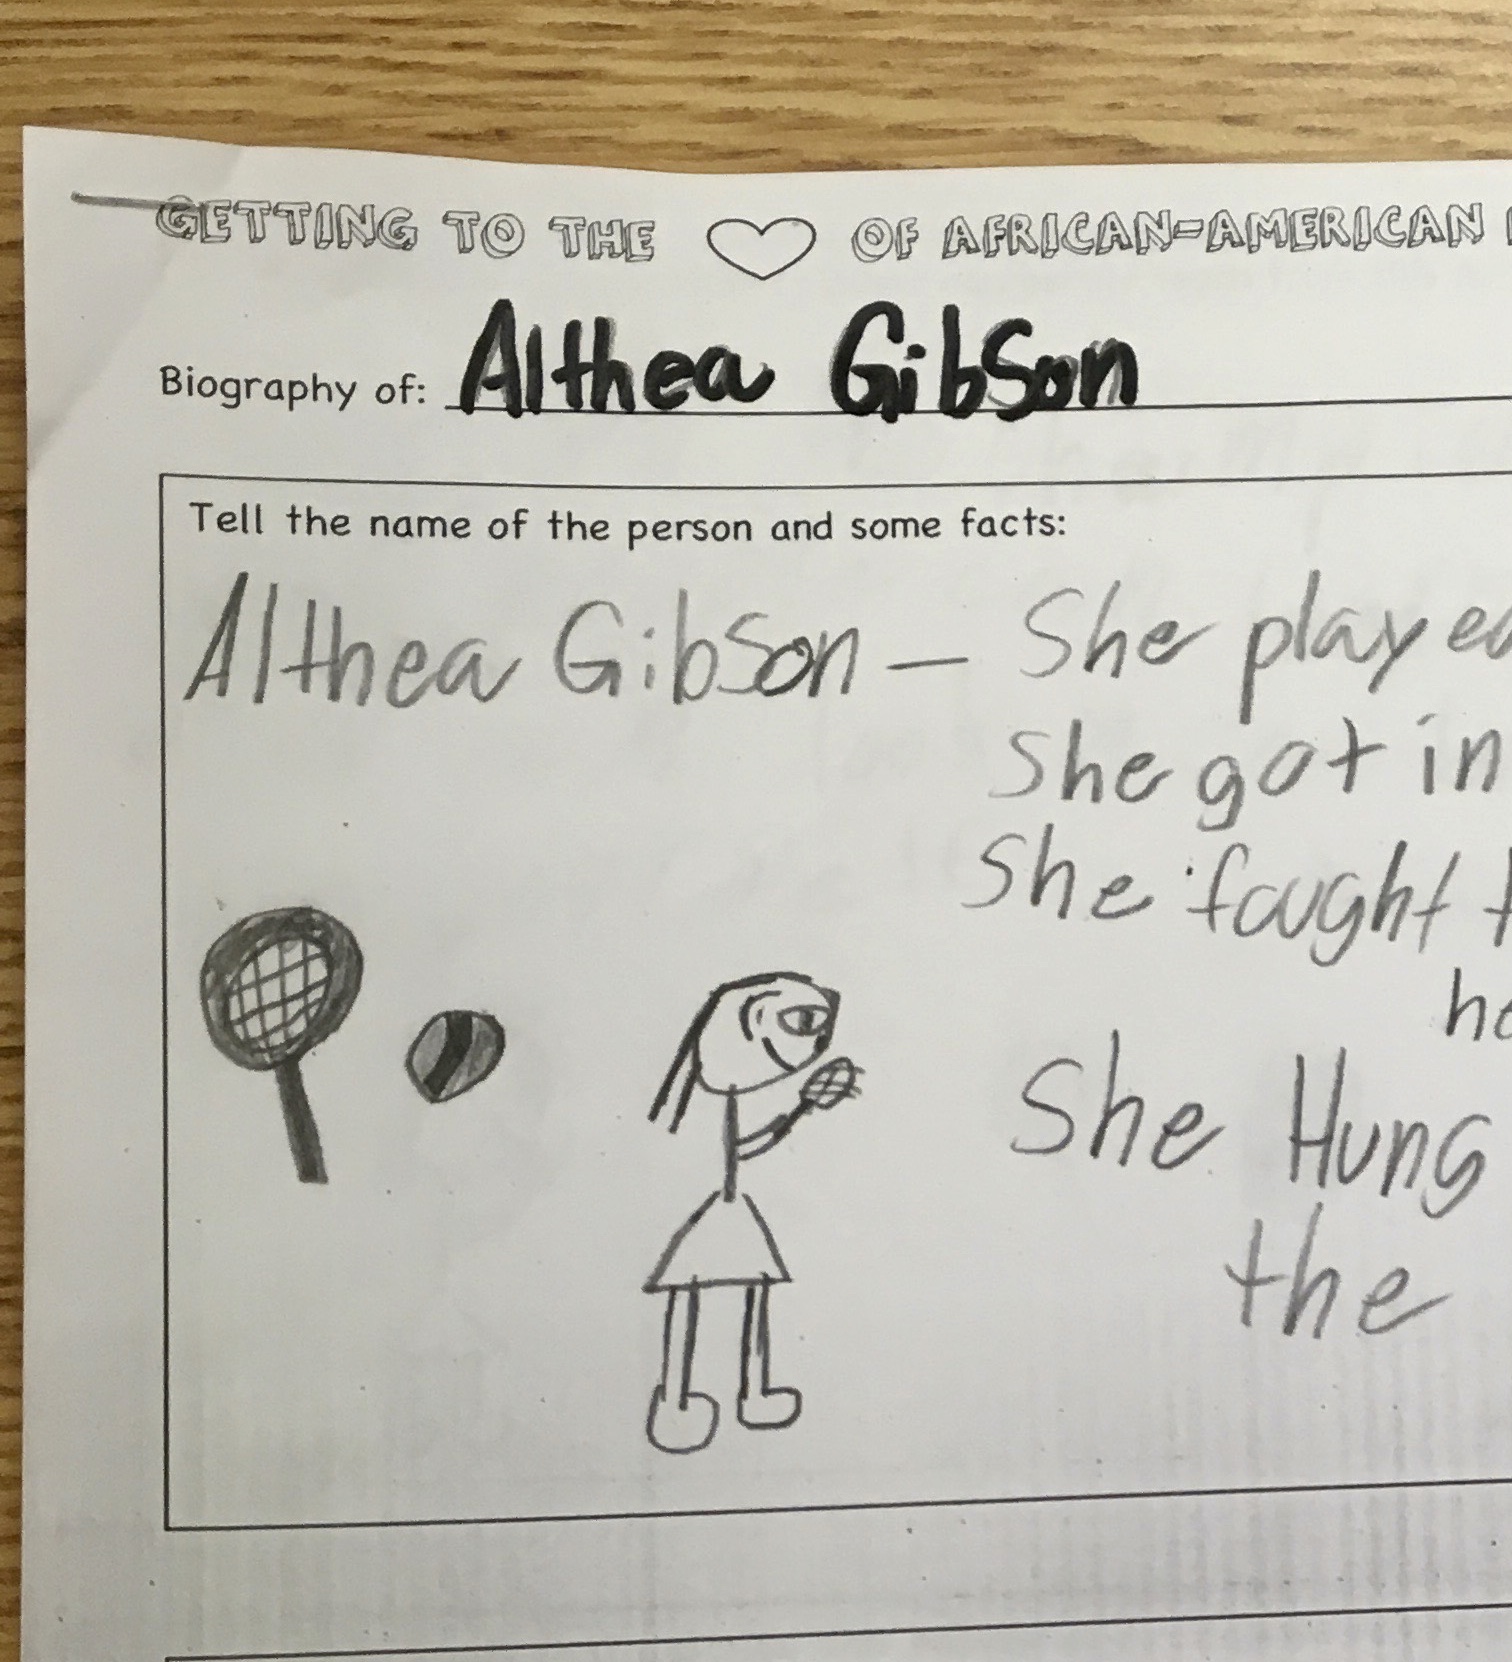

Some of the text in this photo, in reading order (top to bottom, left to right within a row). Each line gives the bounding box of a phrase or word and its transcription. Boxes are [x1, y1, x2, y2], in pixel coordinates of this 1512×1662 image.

[156, 196, 418, 250] GETTING
[442, 209, 526, 260] TO
[548, 217, 656, 262] THE
[850, 214, 920, 262] OF
[942, 202, 1486, 260] AFRICAN-AMERICAN
[160, 366, 427, 413] Biography of:
[458, 299, 776, 418] Althea
[189, 501, 1067, 551] Tell the name of the person and some facts:
[184, 570, 524, 706] Althea
[1020, 576, 1216, 680] She
[990, 718, 1174, 803] She
[1198, 718, 1386, 830] got
[1420, 713, 1502, 793] in
[962, 825, 1155, 922] She
[1011, 1030, 1226, 1170] She
[1224, 1202, 1450, 1340] the
